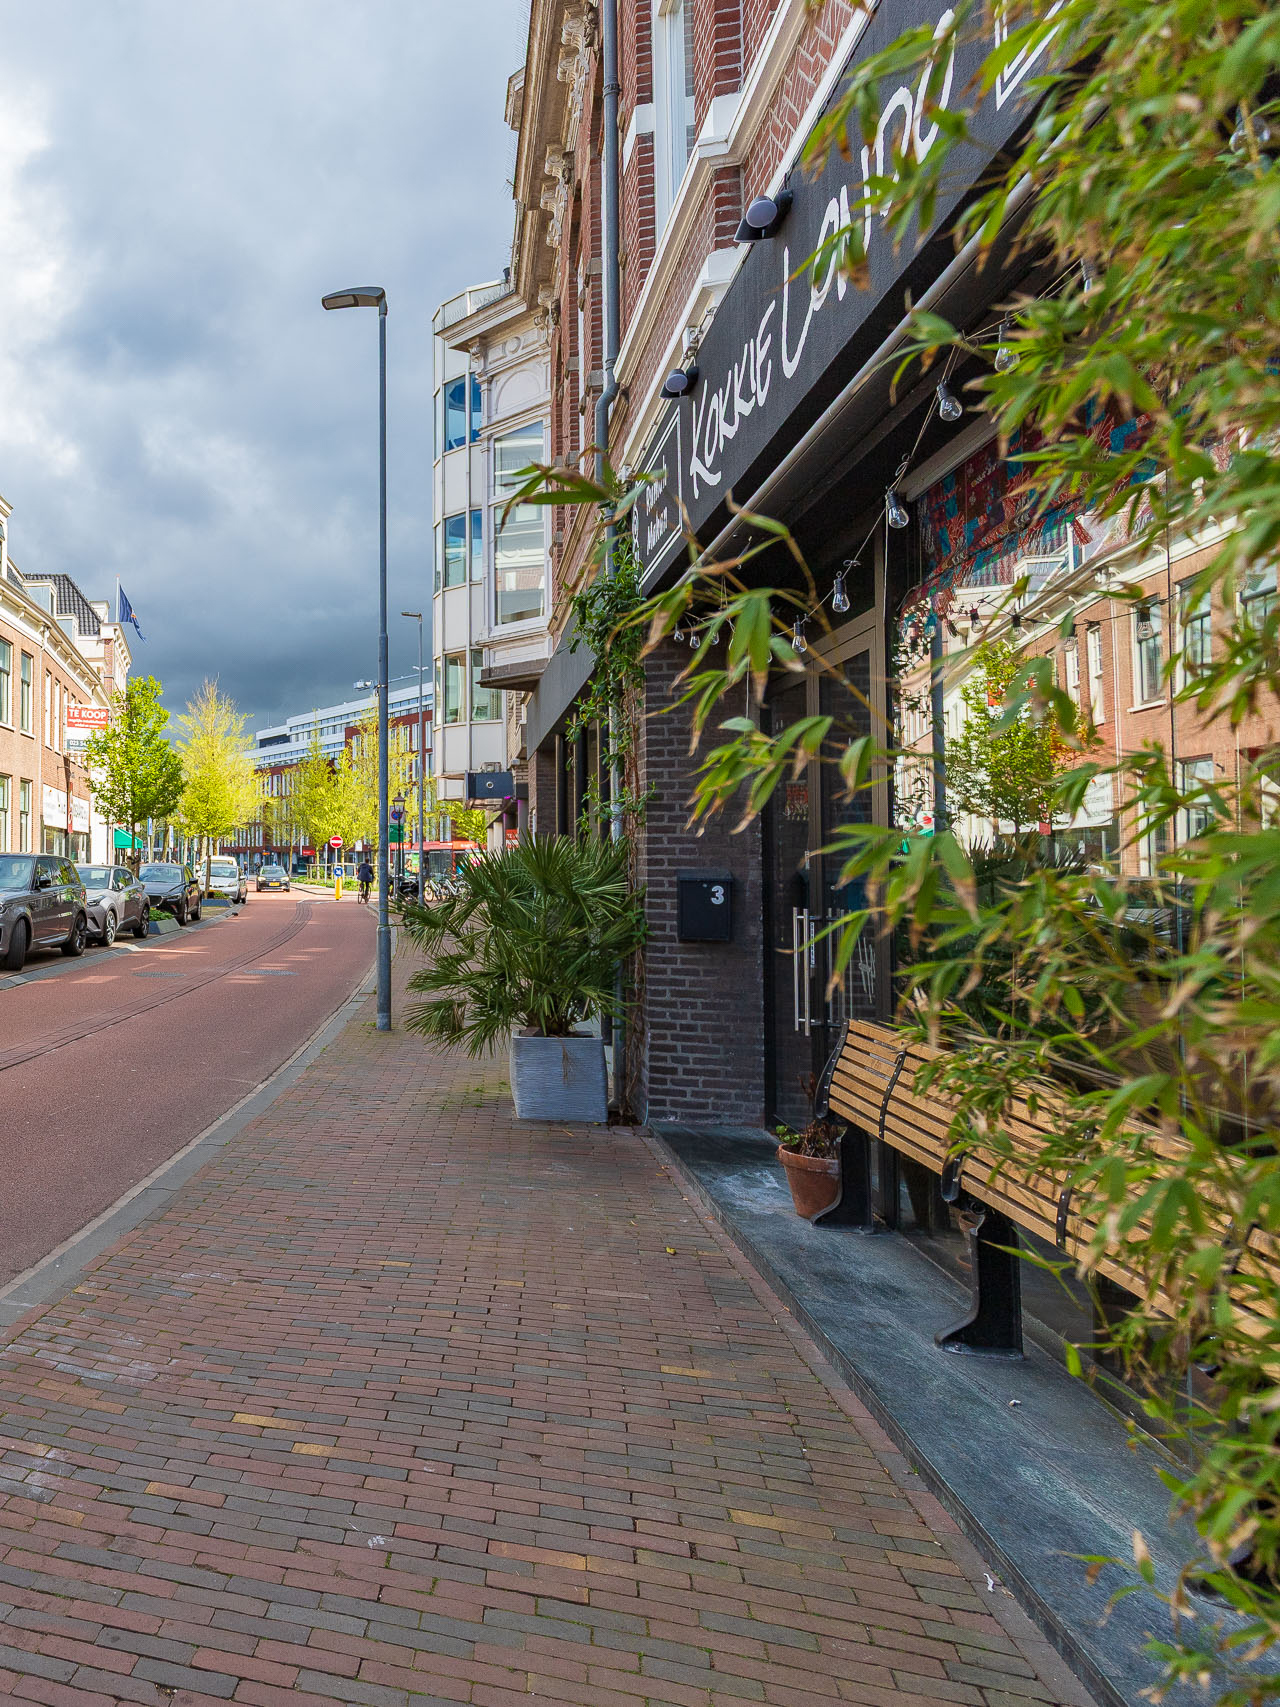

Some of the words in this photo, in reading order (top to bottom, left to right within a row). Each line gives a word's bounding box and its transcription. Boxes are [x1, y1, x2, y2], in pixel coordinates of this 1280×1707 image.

[690, 300, 776, 499] KOKKIE
[69, 709, 79, 718] TE
[81, 709, 107, 719] KOOP
[711, 885, 725, 905] 3
